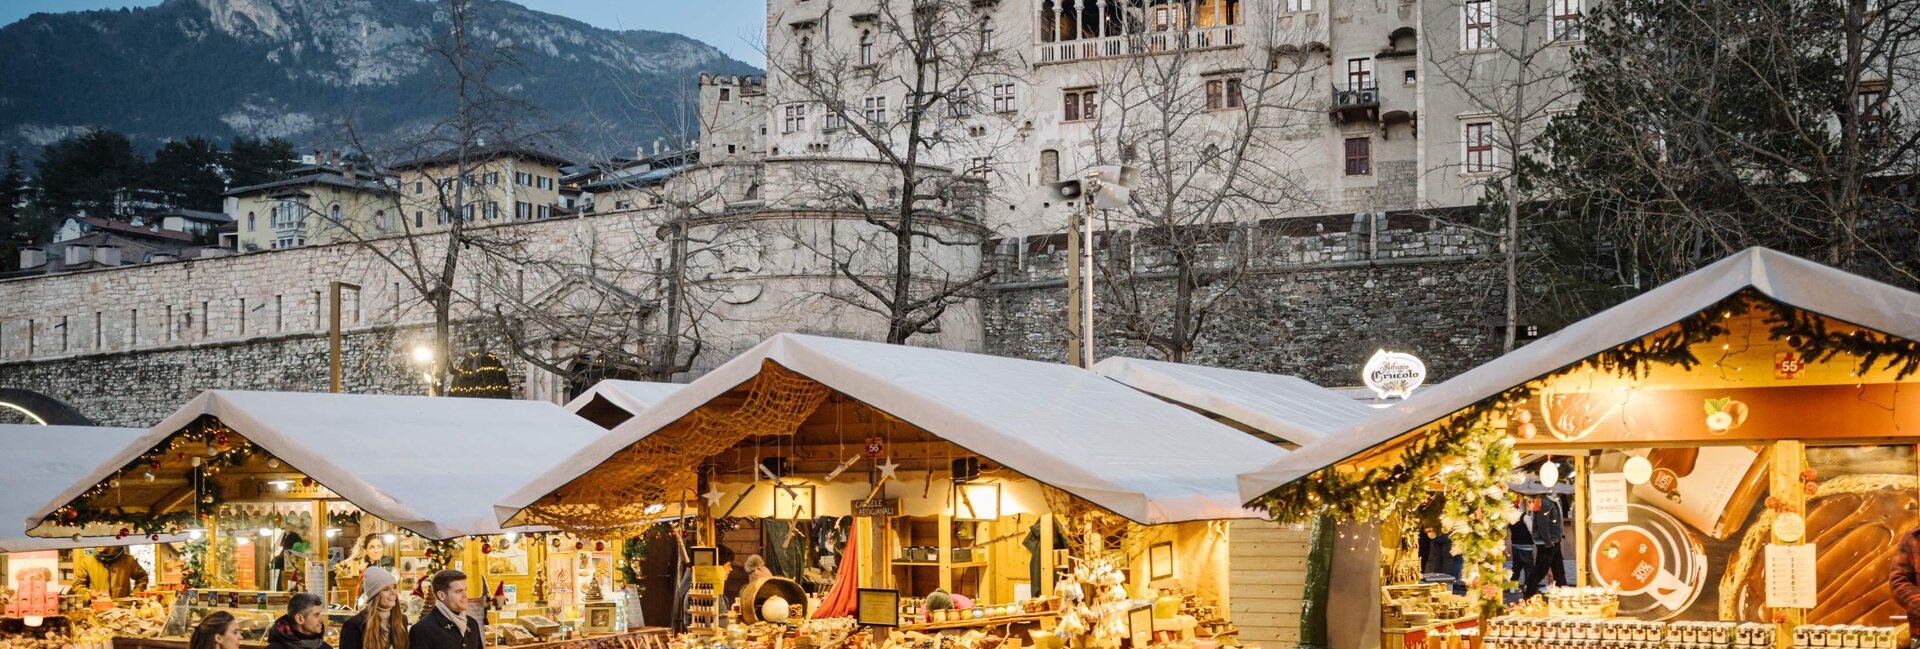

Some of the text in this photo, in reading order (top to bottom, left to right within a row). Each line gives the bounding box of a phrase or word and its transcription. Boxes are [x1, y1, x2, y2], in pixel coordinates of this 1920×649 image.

[1782, 360, 1798, 372] 55
[1371, 369, 1419, 383] Crucolo
[869, 443, 879, 452] 56
